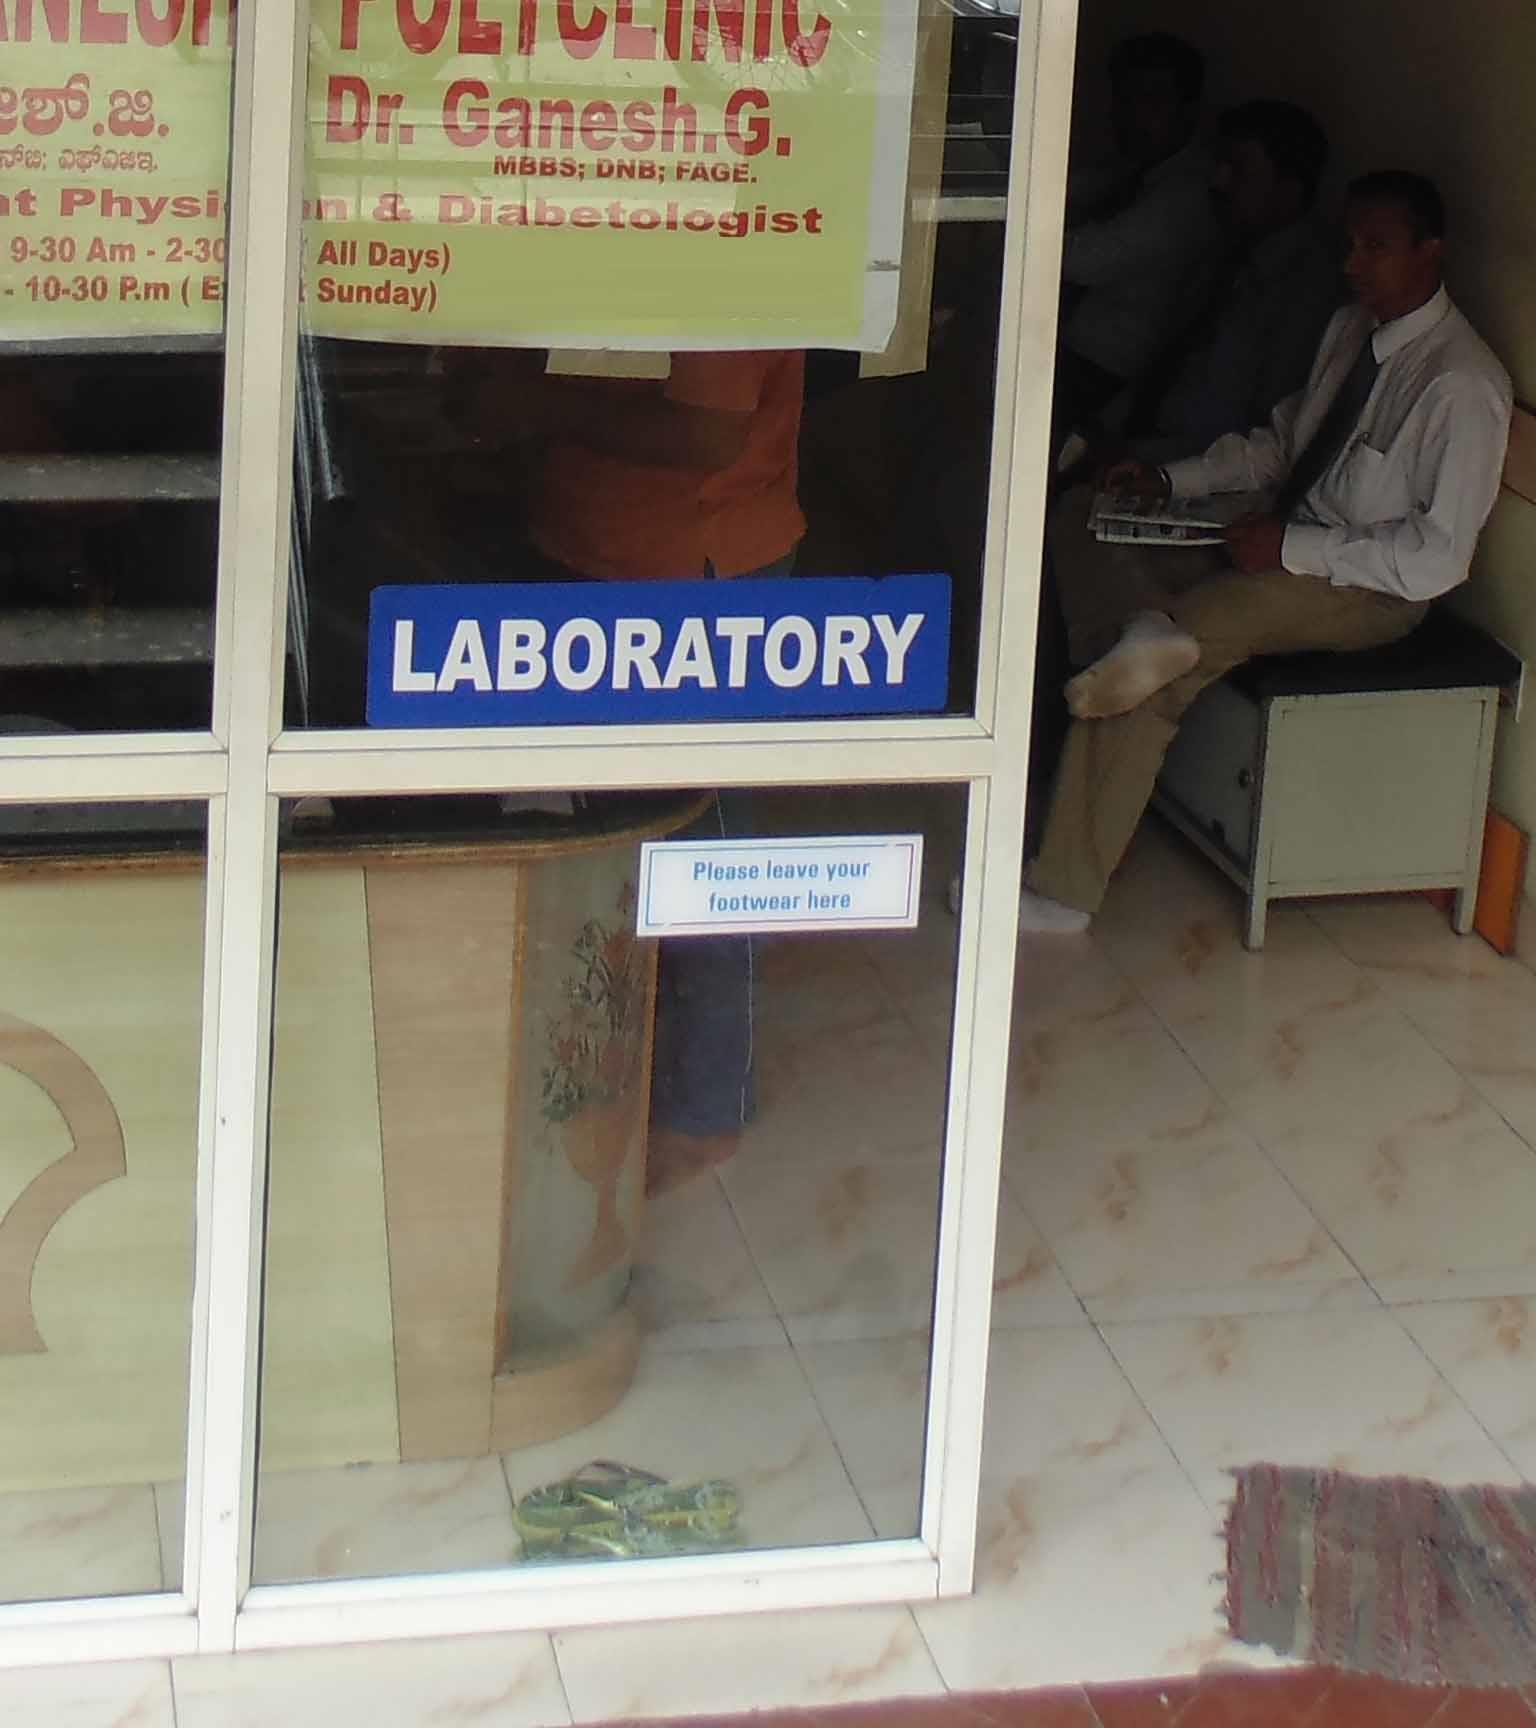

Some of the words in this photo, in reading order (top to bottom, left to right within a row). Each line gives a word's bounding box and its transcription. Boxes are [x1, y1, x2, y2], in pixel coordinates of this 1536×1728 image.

[325, 74, 414, 145] Dr.
[442, 79, 792, 157] Ganesh.G.
[492, 155, 585, 181] MBBS;
[596, 158, 665, 183] DNB;
[675, 161, 758, 184] FAGE.
[372, 193, 412, 221] &
[438, 195, 824, 237] Diabetologist
[10, 236, 76, 263] 9-30
[87, 238, 136, 263] Am
[317, 239, 357, 267] All
[368, 241, 452, 275] Days)
[25, 275, 109, 303] 10-30
[119, 276, 170, 302] P.m
[317, 277, 438, 312] Sunday)
[391, 613, 925, 693] LABORATORY
[693, 861, 759, 881] Please
[766, 860, 819, 880] leave
[826, 861, 871, 881] your
[709, 892, 800, 913] footwear
[808, 889, 851, 909] here
